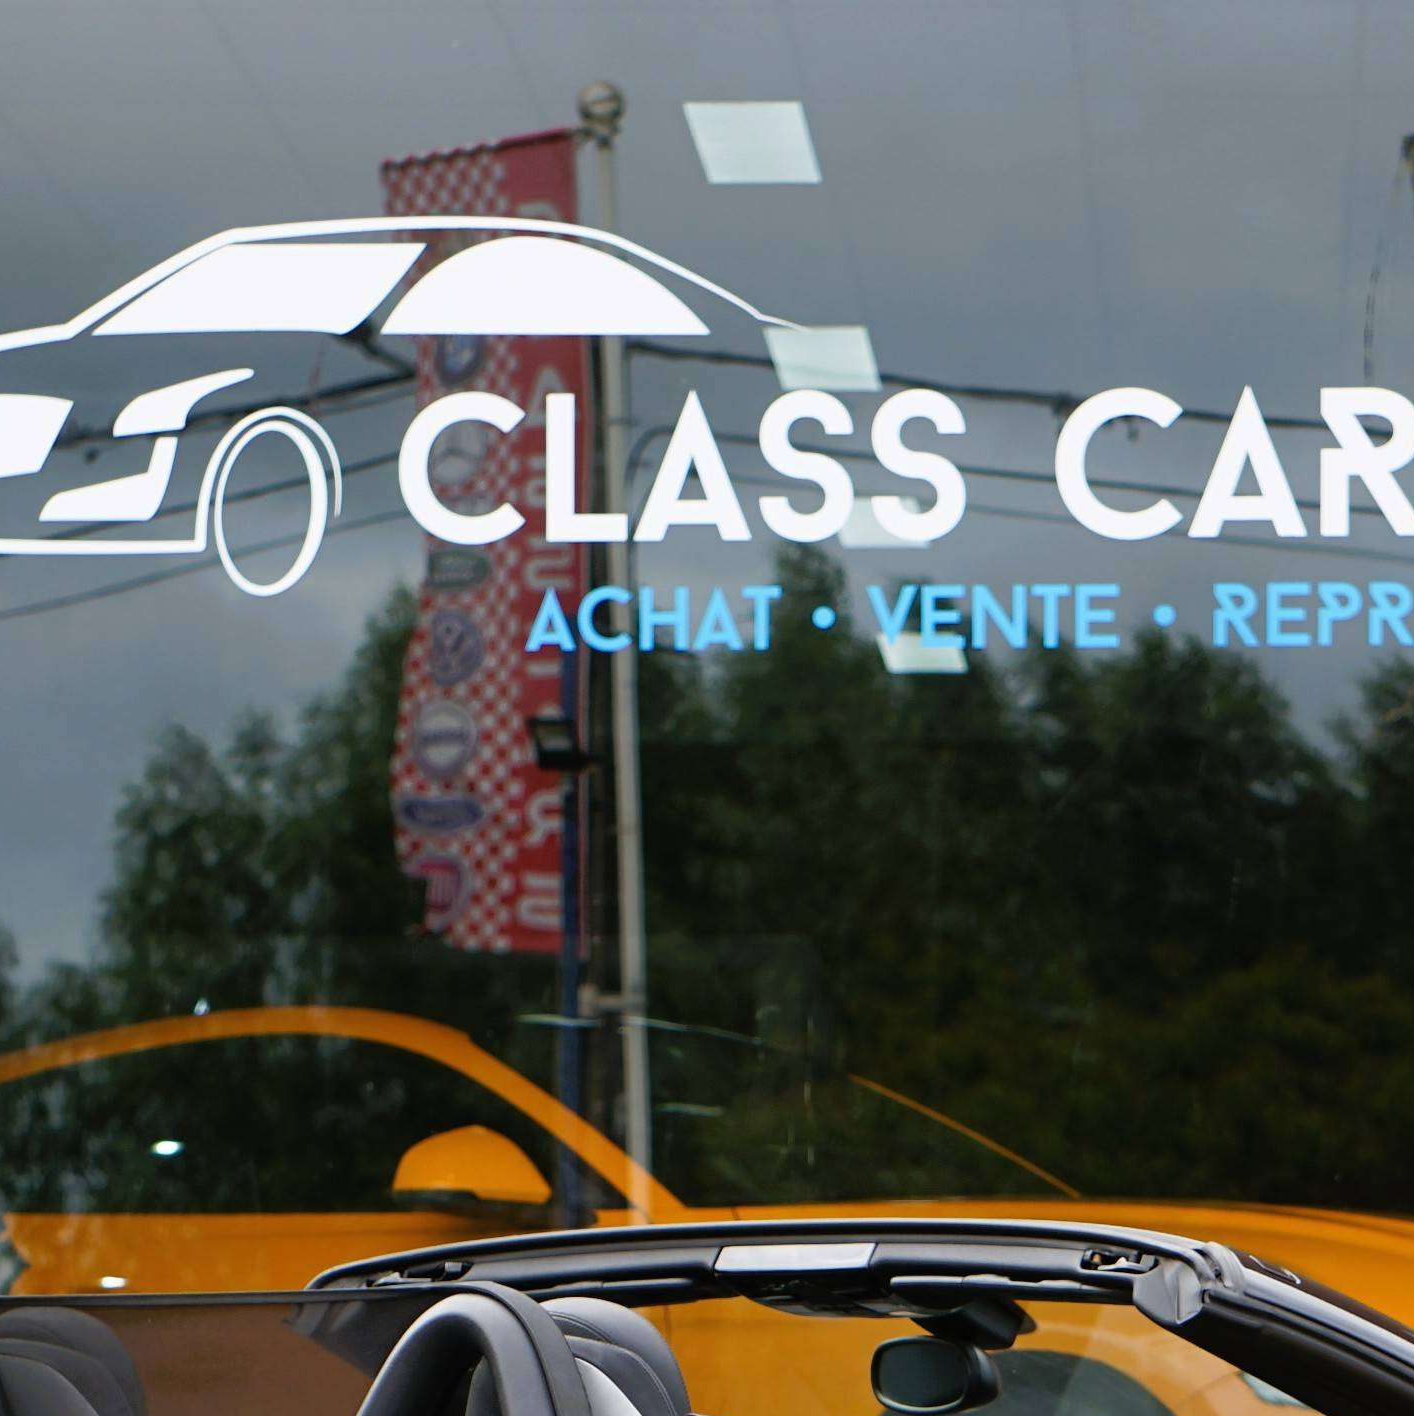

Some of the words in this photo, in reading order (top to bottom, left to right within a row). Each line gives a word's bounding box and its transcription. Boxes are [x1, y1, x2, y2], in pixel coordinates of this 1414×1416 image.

[399, 390, 966, 545] CLASS
[525, 585, 783, 654] ACHAT
[865, 582, 1123, 651] VENTE
